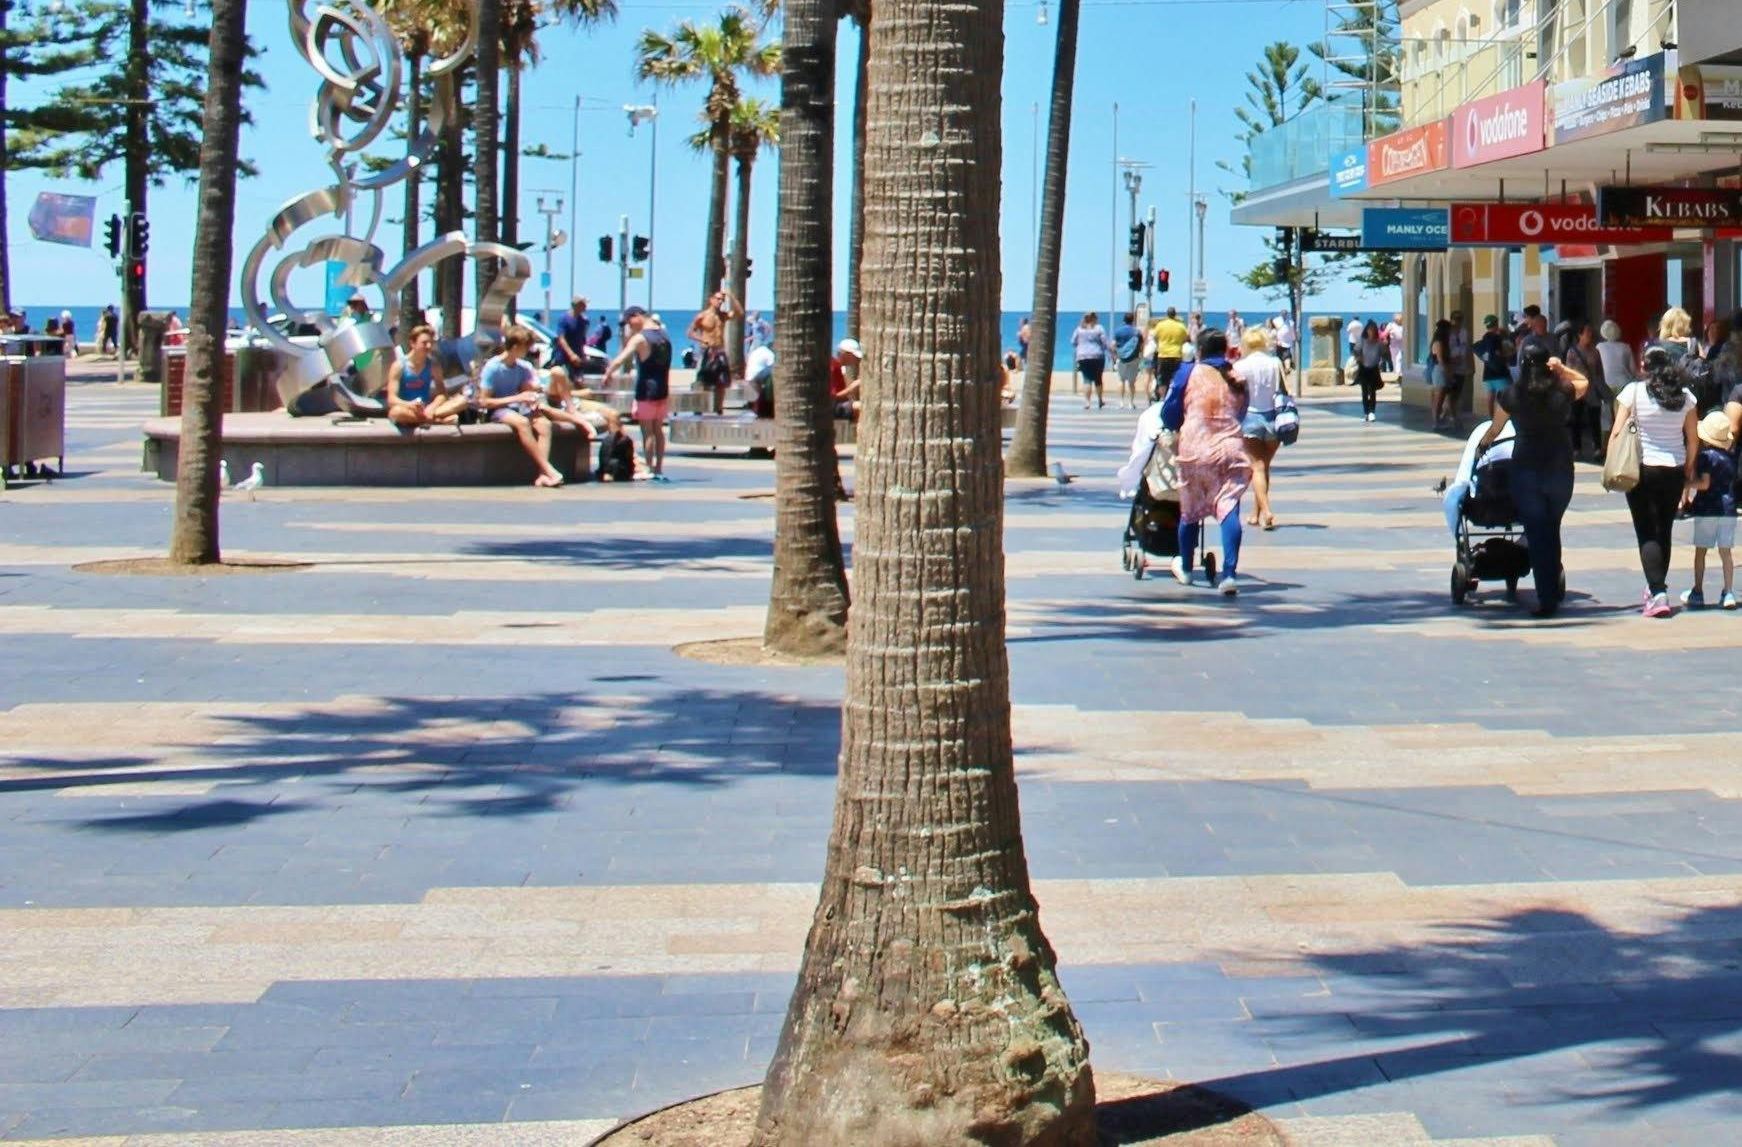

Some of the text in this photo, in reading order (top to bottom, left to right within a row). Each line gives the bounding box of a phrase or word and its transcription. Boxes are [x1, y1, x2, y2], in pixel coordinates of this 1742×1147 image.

[1587, 78, 1618, 108] SEASIDE
[1619, 70, 1651, 99] KEBABS
[1480, 103, 1528, 146] vodafone
[1646, 196, 1730, 219] KEBABS
[1386, 224, 1448, 235] MANLY OCE
[1314, 238, 1361, 249] STARBU
